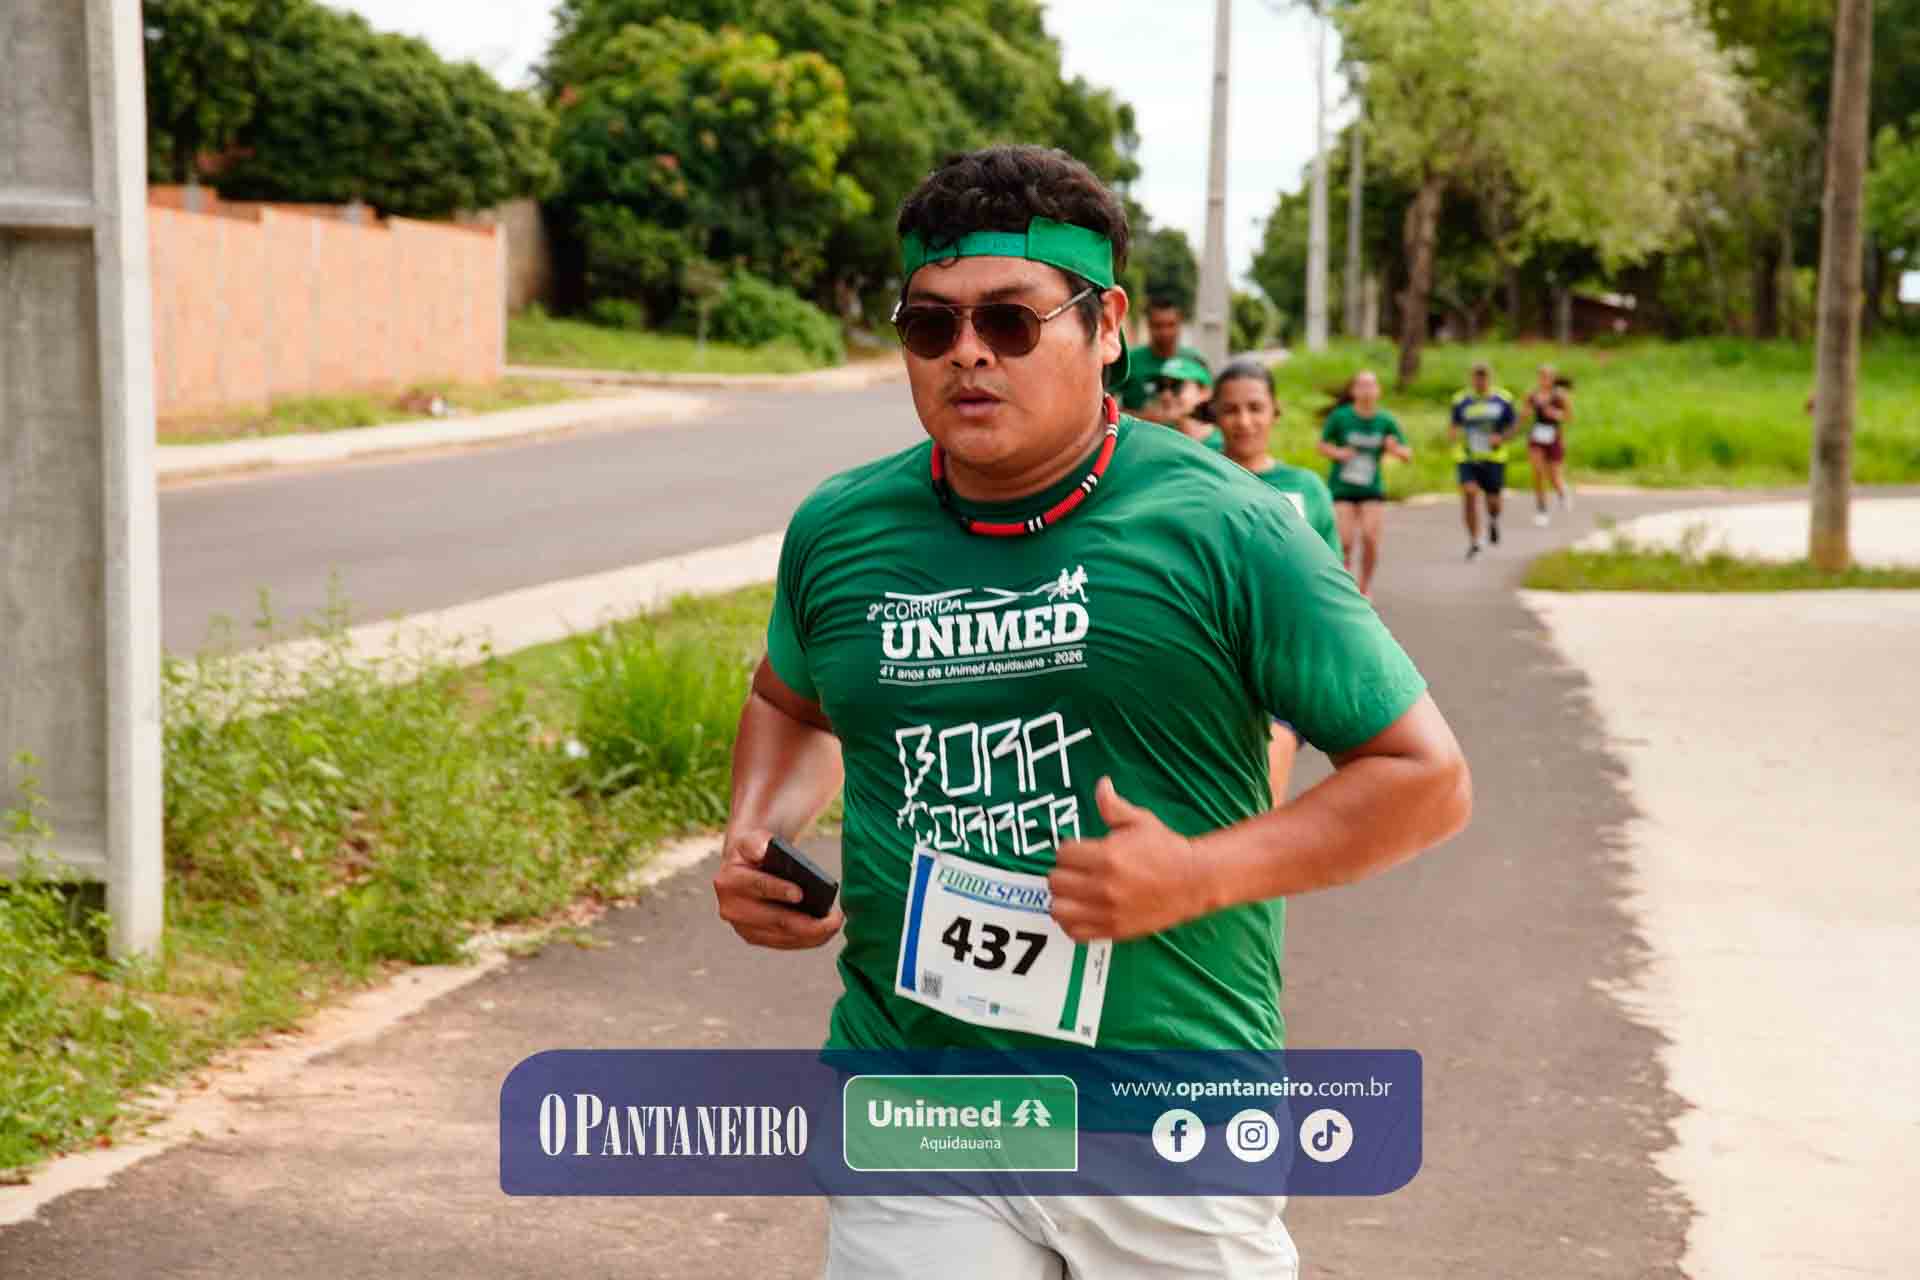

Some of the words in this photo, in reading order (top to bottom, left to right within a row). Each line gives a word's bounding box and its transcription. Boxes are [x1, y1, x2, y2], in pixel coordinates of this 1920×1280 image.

[880, 602, 1090, 659] UNIMED
[883, 599, 962, 621] CORRIDA
[879, 664, 895, 678] 41
[896, 668, 925, 681] anos
[944, 662, 986, 677] Unimed
[986, 657, 1045, 674] Aquidauana
[1054, 649, 1083, 665] 2026
[895, 711, 1092, 798] BORA
[897, 794, 1081, 857] CORRER
[936, 865, 1054, 910] FUNDESPOR
[941, 915, 1048, 976] 437
